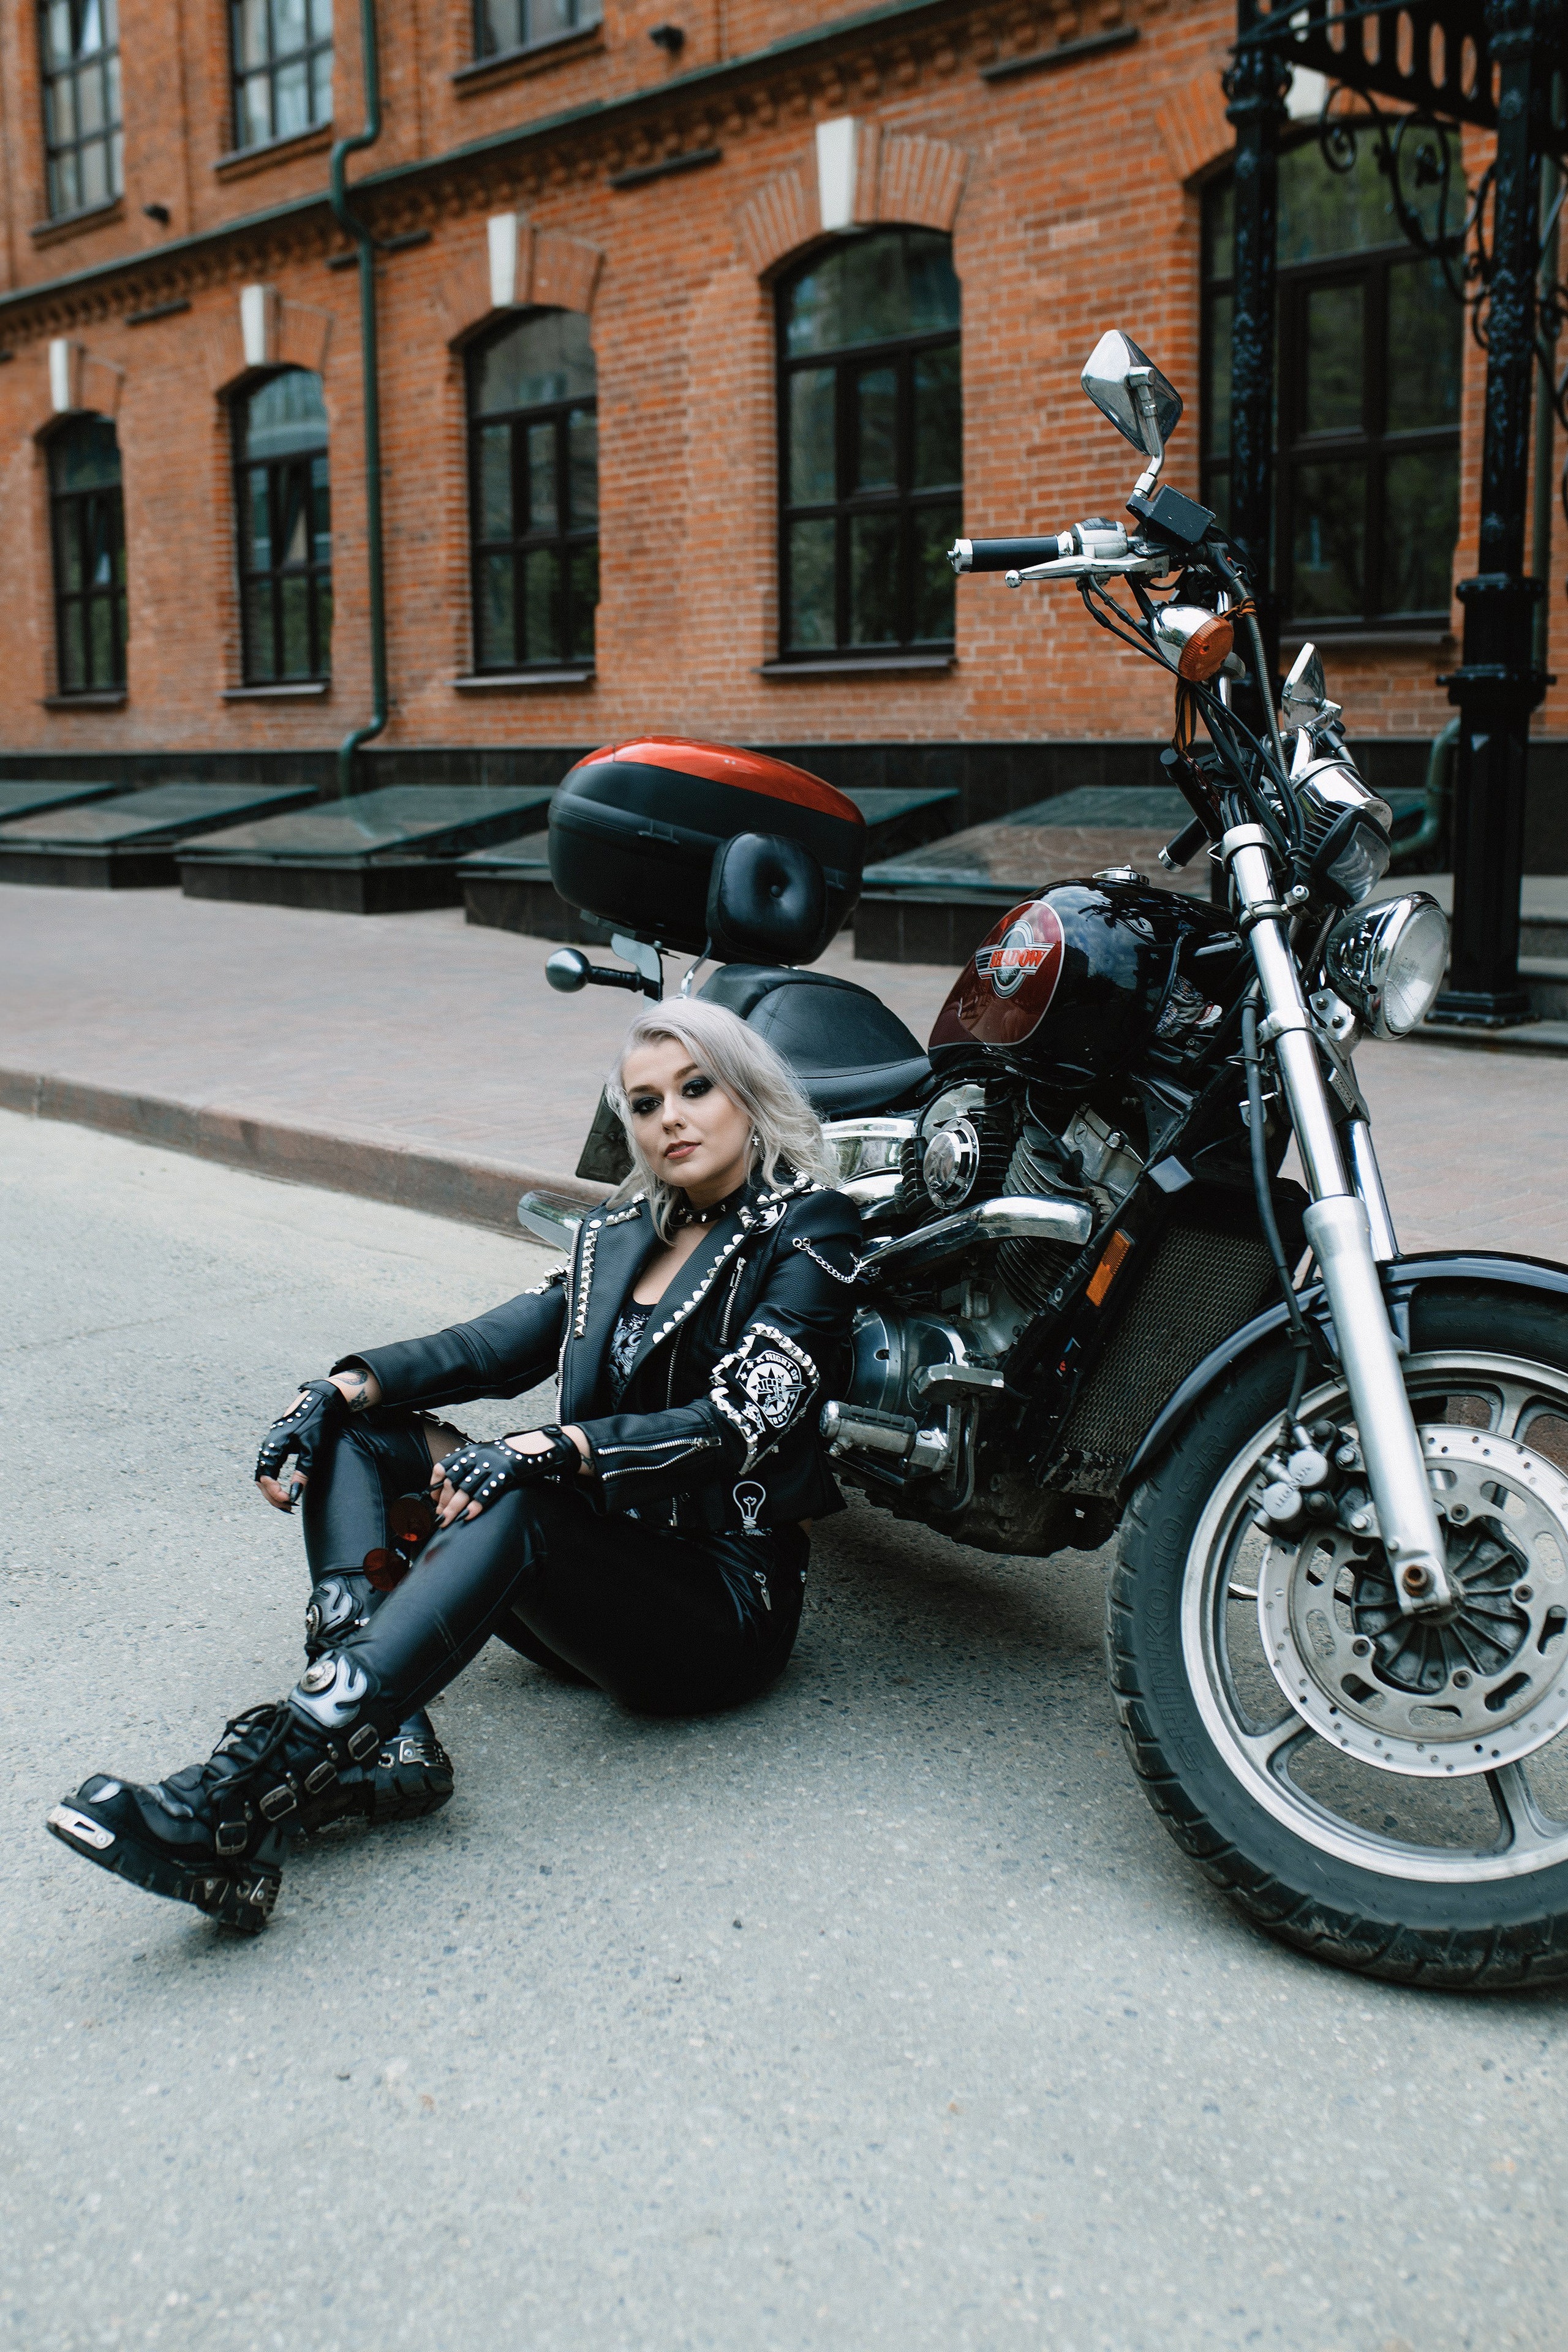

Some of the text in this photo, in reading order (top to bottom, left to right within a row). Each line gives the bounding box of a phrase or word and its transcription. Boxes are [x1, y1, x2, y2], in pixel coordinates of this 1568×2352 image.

[990, 949, 1047, 967] SHADOW
[764, 1353, 793, 1370] NIGHT
[790, 1368, 799, 1381] OF
[1275, 1466, 1312, 1507] HONDA
[1144, 1589, 1208, 1774] SHINKO
